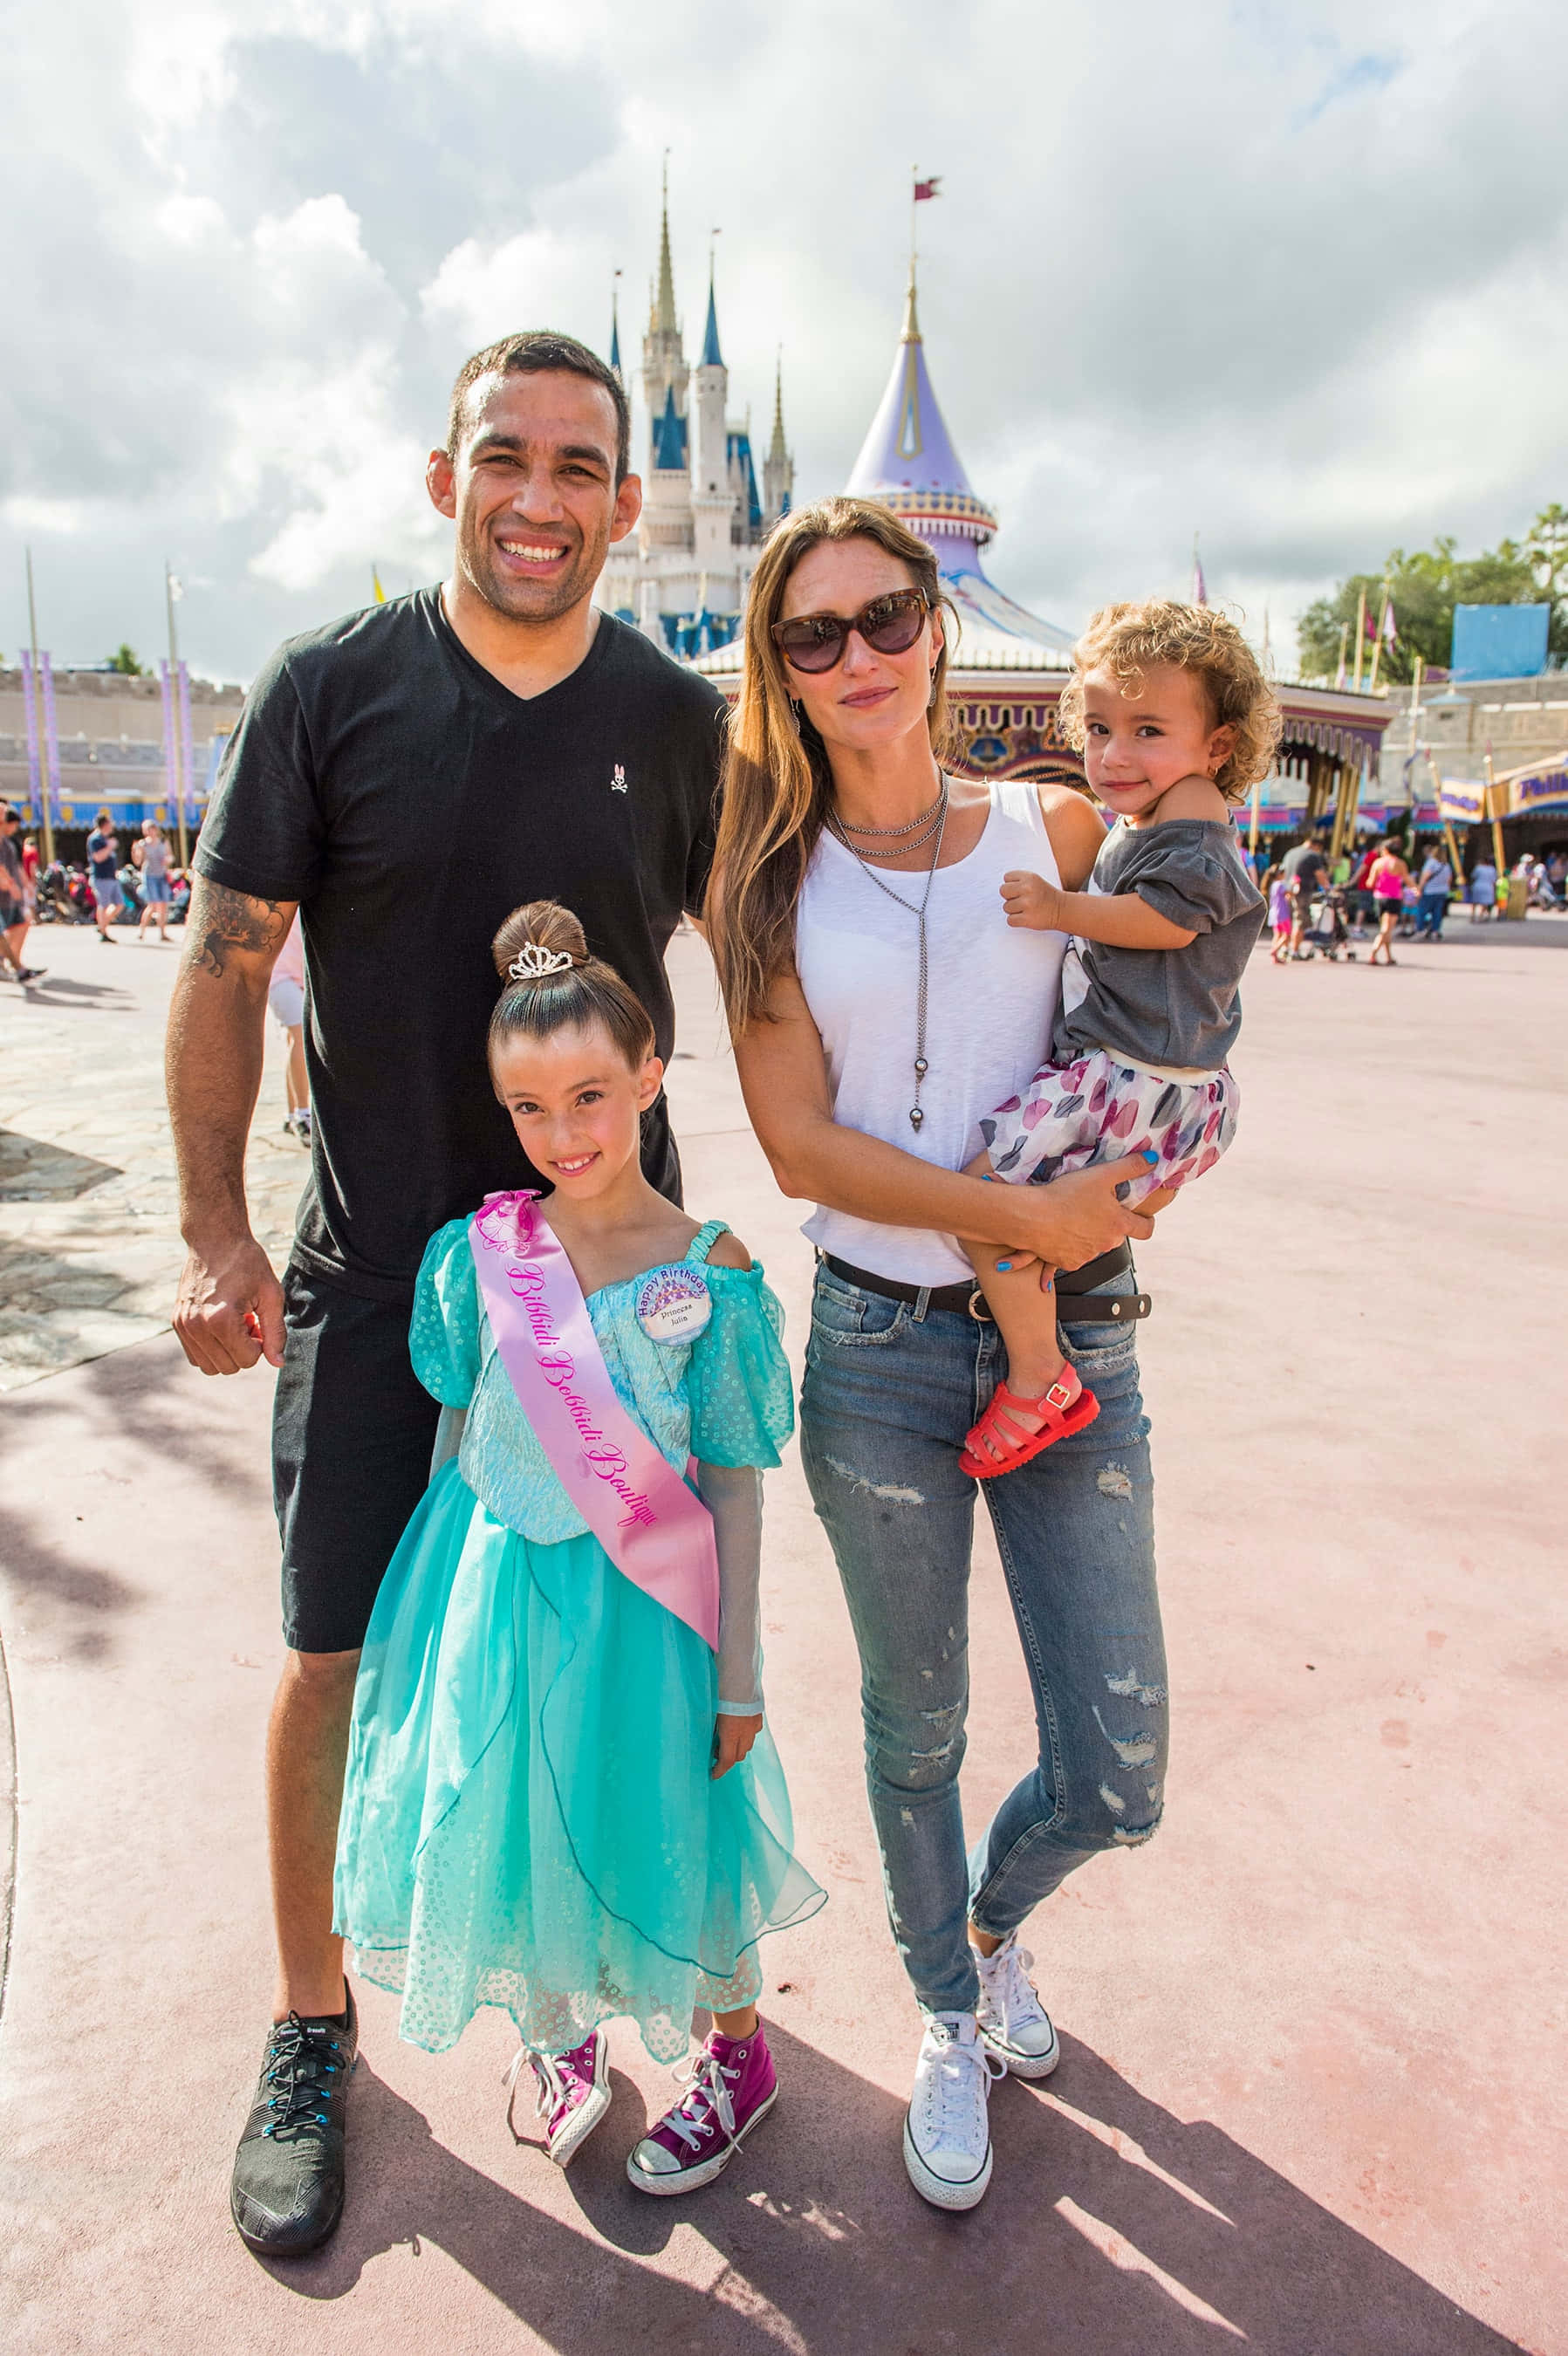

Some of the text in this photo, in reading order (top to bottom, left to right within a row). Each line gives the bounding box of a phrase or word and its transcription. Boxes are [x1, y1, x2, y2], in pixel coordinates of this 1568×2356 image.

[638, 1268, 708, 1317] Happy Birthday
[504, 1263, 561, 1346] Bibbidi
[536, 1350, 604, 1442] Bobbidi
